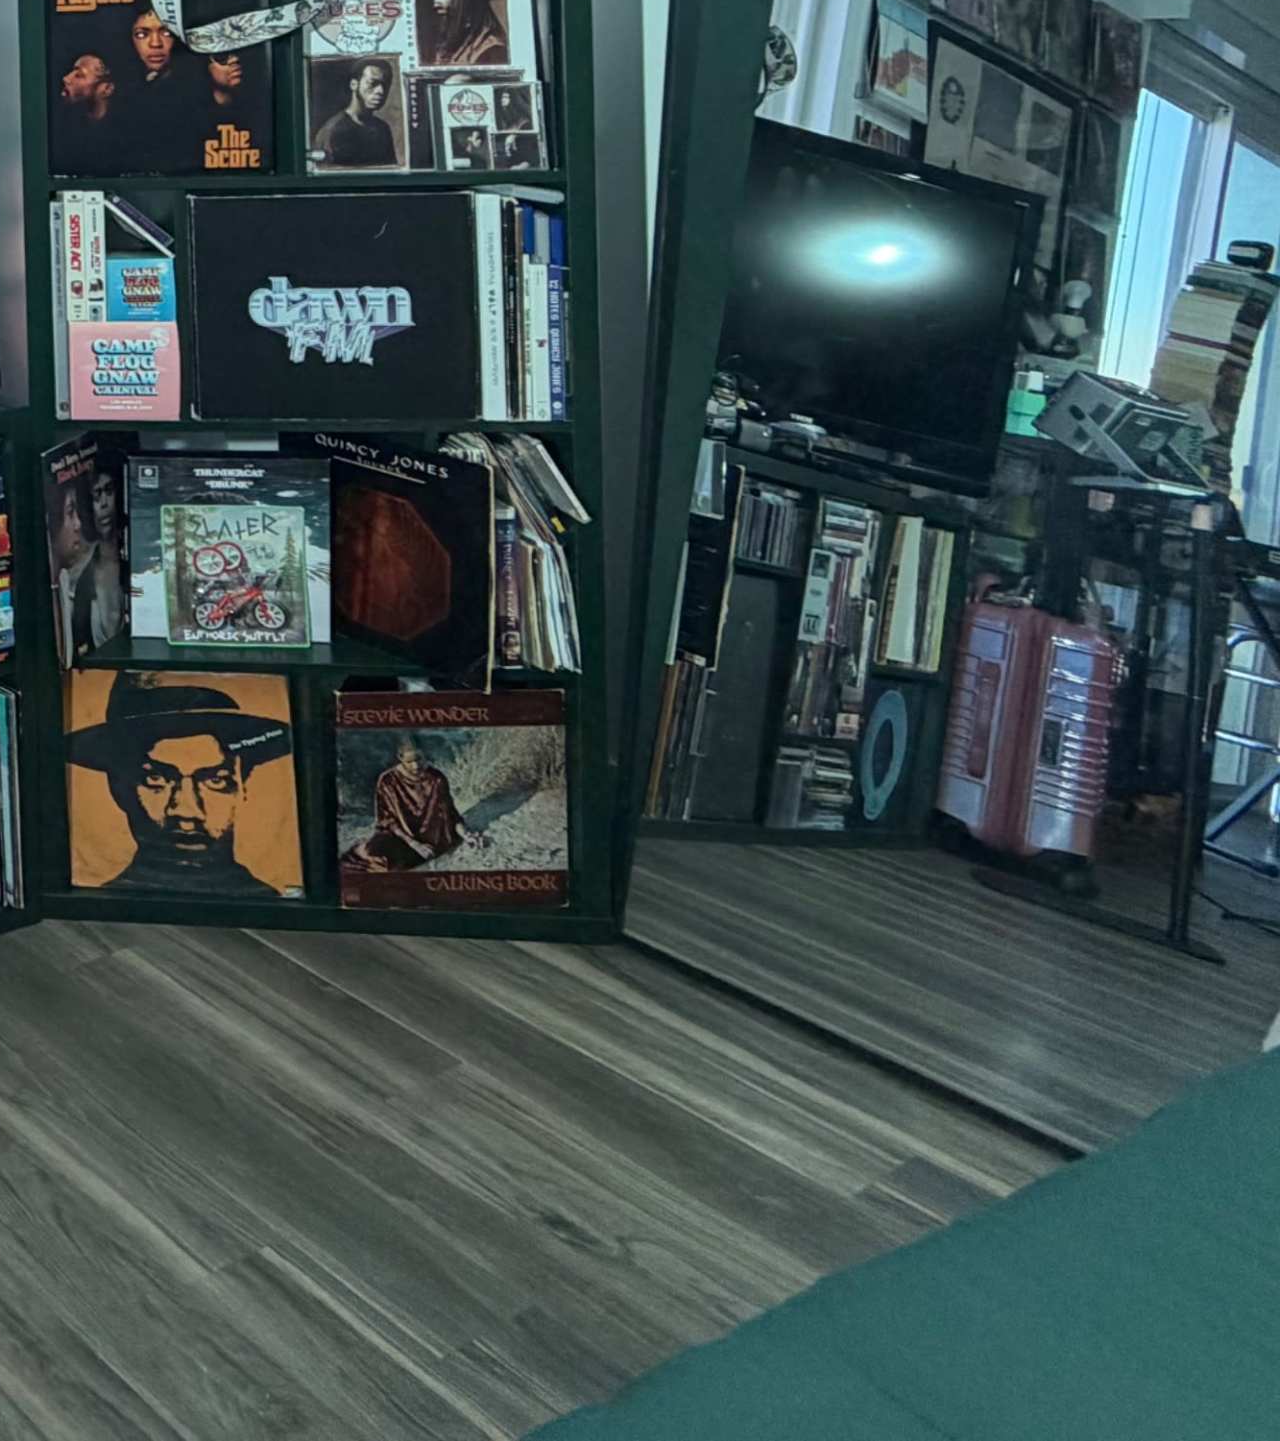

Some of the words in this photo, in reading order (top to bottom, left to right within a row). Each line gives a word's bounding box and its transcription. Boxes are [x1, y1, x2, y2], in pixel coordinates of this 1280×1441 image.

[218, 124, 250, 150] The
[205, 145, 261, 170] Score
[69, 214, 81, 249] SISTER
[70, 250, 82, 272] ACT
[123, 284, 162, 295] GNAW
[248, 276, 416, 328] dawn
[92, 338, 158, 354] CAMP
[285, 320, 374, 366] FM
[96, 354, 156, 370] FLOG
[92, 370, 160, 386] GNAW
[314, 432, 381, 459] QUINCY
[390, 454, 449, 479] JONES
[193, 468, 266, 478] THUNDERCAT
[343, 706, 404, 725] STEVIE
[409, 706, 489, 723] WONDER
[266, 728, 285, 741] Point
[426, 875, 503, 893] TALKING
[507, 873, 560, 892] BOOK
